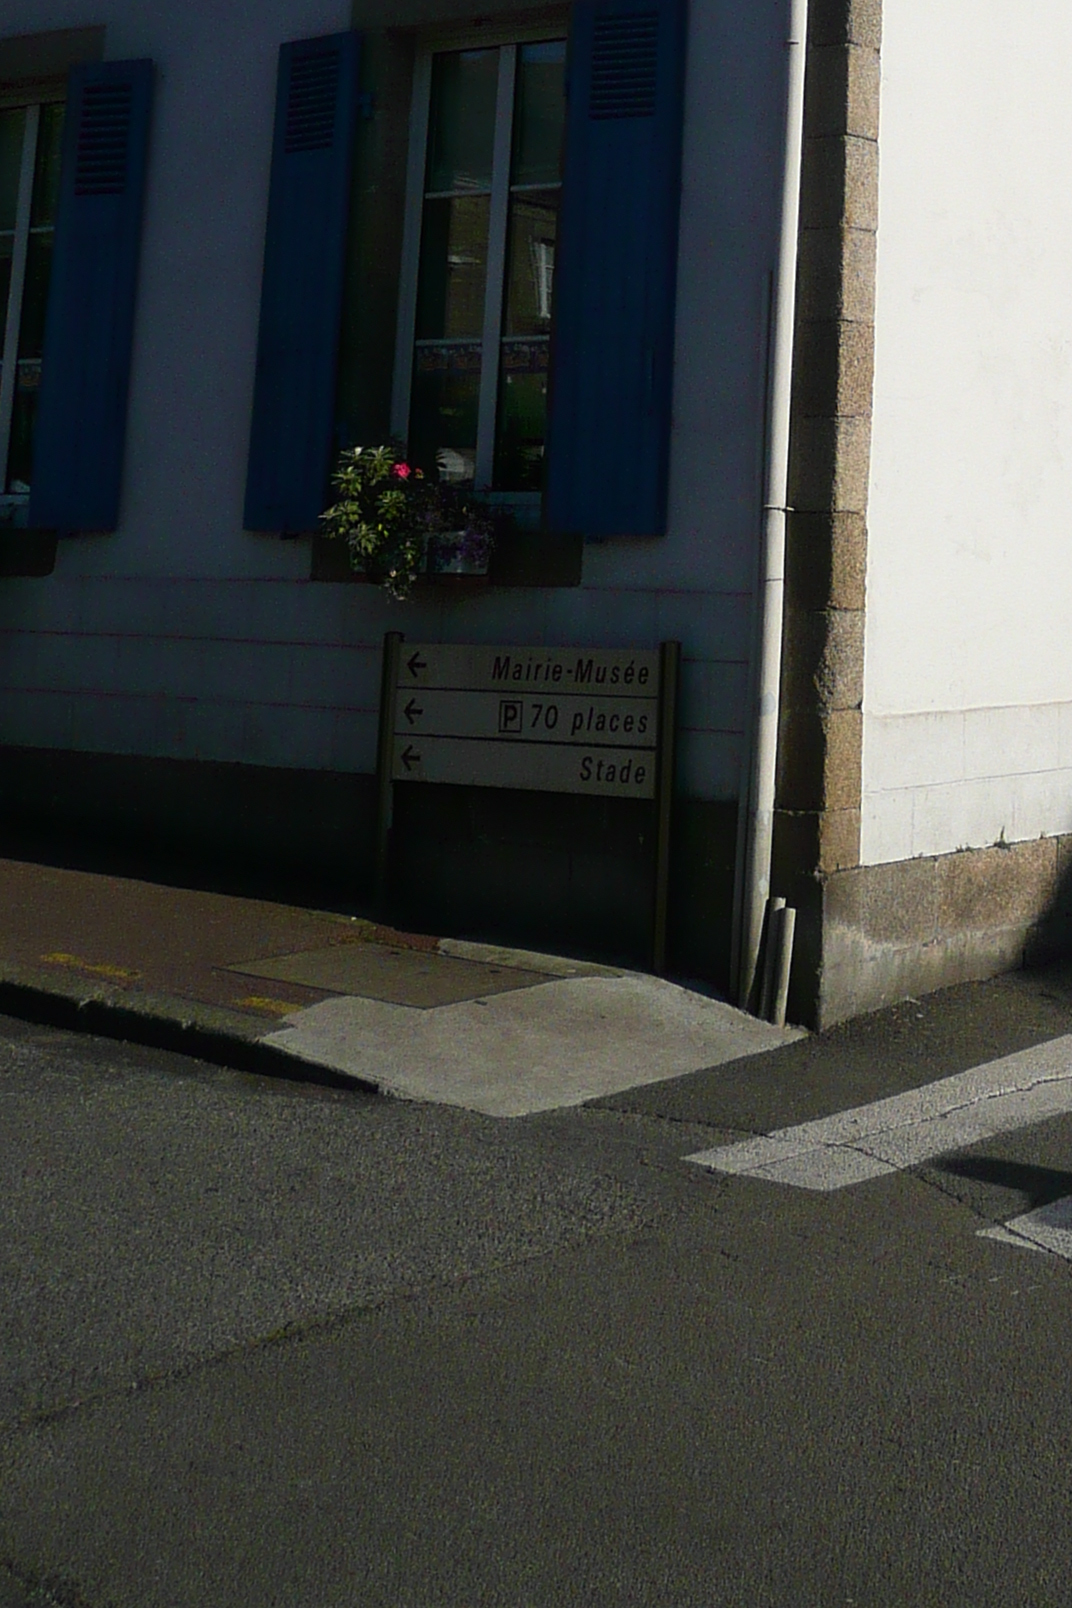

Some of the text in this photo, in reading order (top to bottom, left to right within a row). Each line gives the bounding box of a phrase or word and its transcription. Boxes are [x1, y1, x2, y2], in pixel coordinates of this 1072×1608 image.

[491, 655, 650, 686] Mairie-Musée
[530, 704, 559, 729] 70
[571, 706, 649, 736] places
[579, 756, 647, 784] Stade
